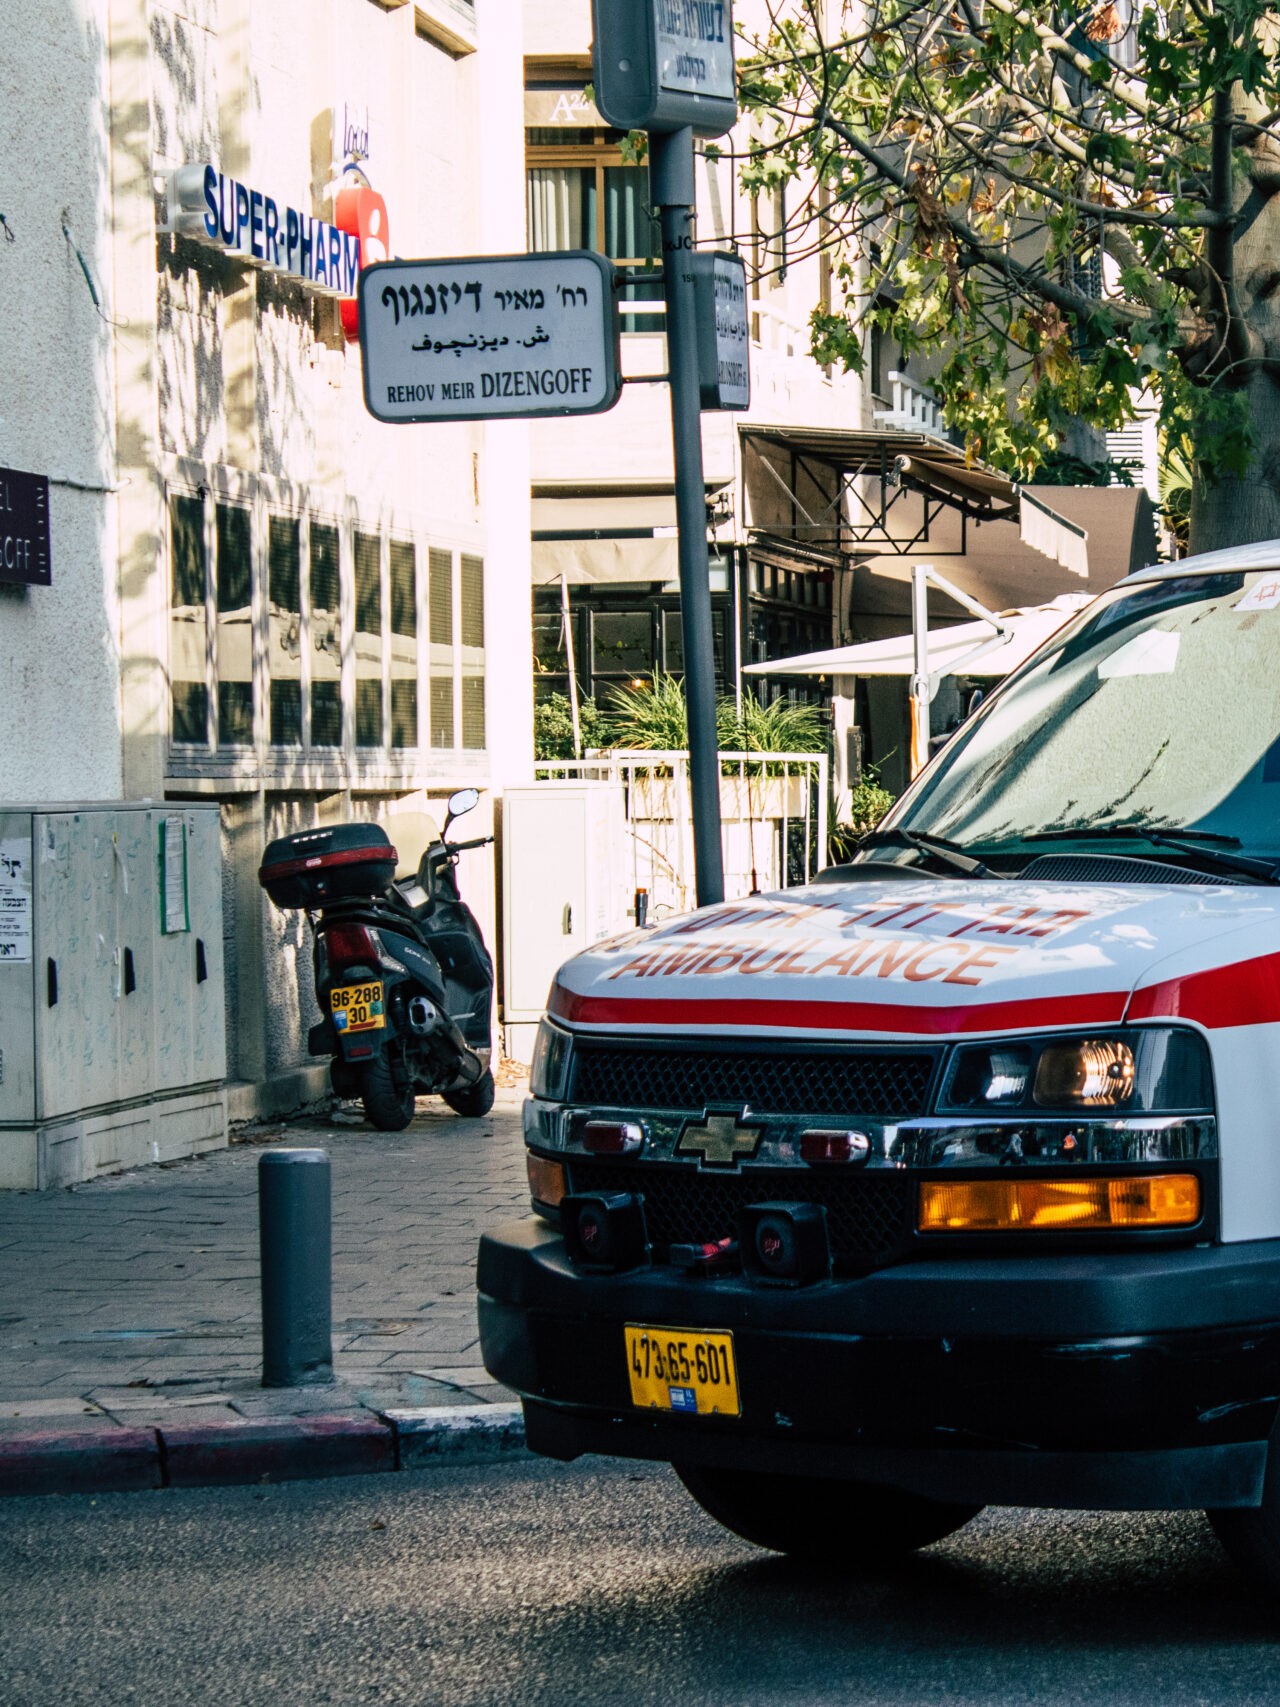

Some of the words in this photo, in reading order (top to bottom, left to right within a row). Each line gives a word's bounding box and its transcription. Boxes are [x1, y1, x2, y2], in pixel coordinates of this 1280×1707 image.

[203, 165, 359, 297] SUPER-PHARM
[381, 281, 482, 326] דיזנגוף
[494, 288, 545, 311] מאיר
[556, 284, 588, 308] רח'
[387, 384, 436, 403] REHOV
[441, 382, 475, 400] MEIR
[481, 368, 592, 398] DIZENGOFF
[608, 938, 1023, 986] AMBULANCE
[331, 985, 381, 1009] 96-288
[349, 1006, 367, 1024] 30
